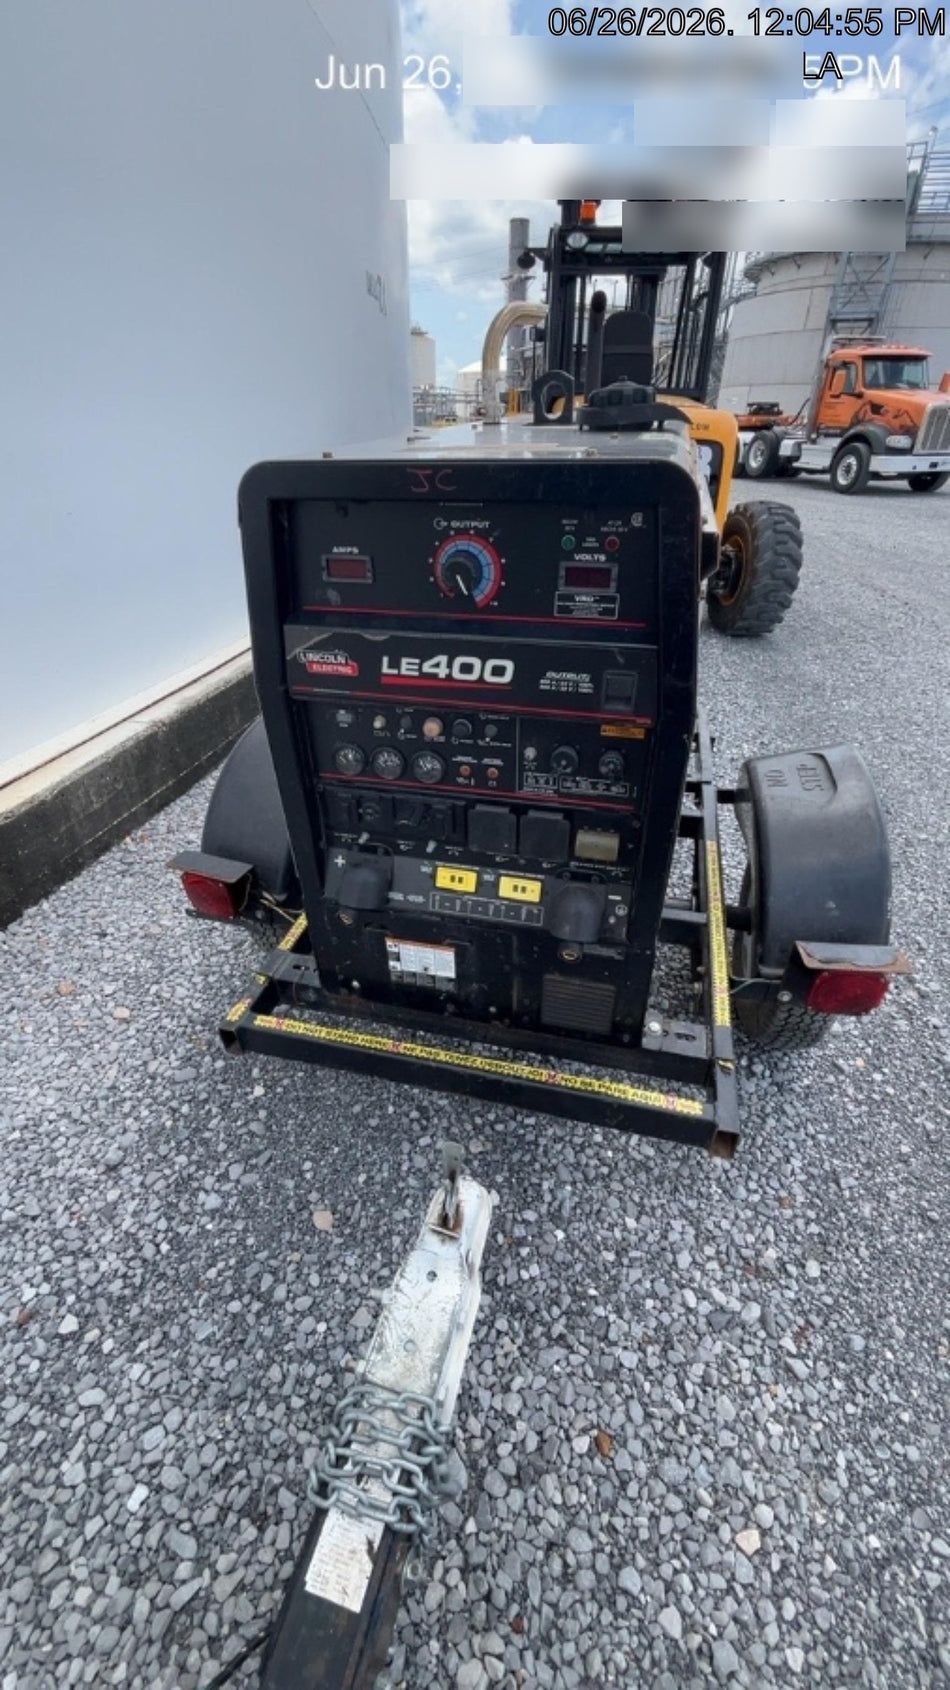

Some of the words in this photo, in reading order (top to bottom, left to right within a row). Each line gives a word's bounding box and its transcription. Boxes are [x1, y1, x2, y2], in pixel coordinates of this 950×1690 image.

[450, 520, 490, 529] OUTPUT
[332, 546, 359, 554] AMPS
[574, 553, 606, 562] VOLTS
[300, 651, 347, 664] LINCOLN
[311, 663, 353, 674] ELECTRIC
[381, 655, 515, 685] LE400
[796, 764, 824, 791] STEP
